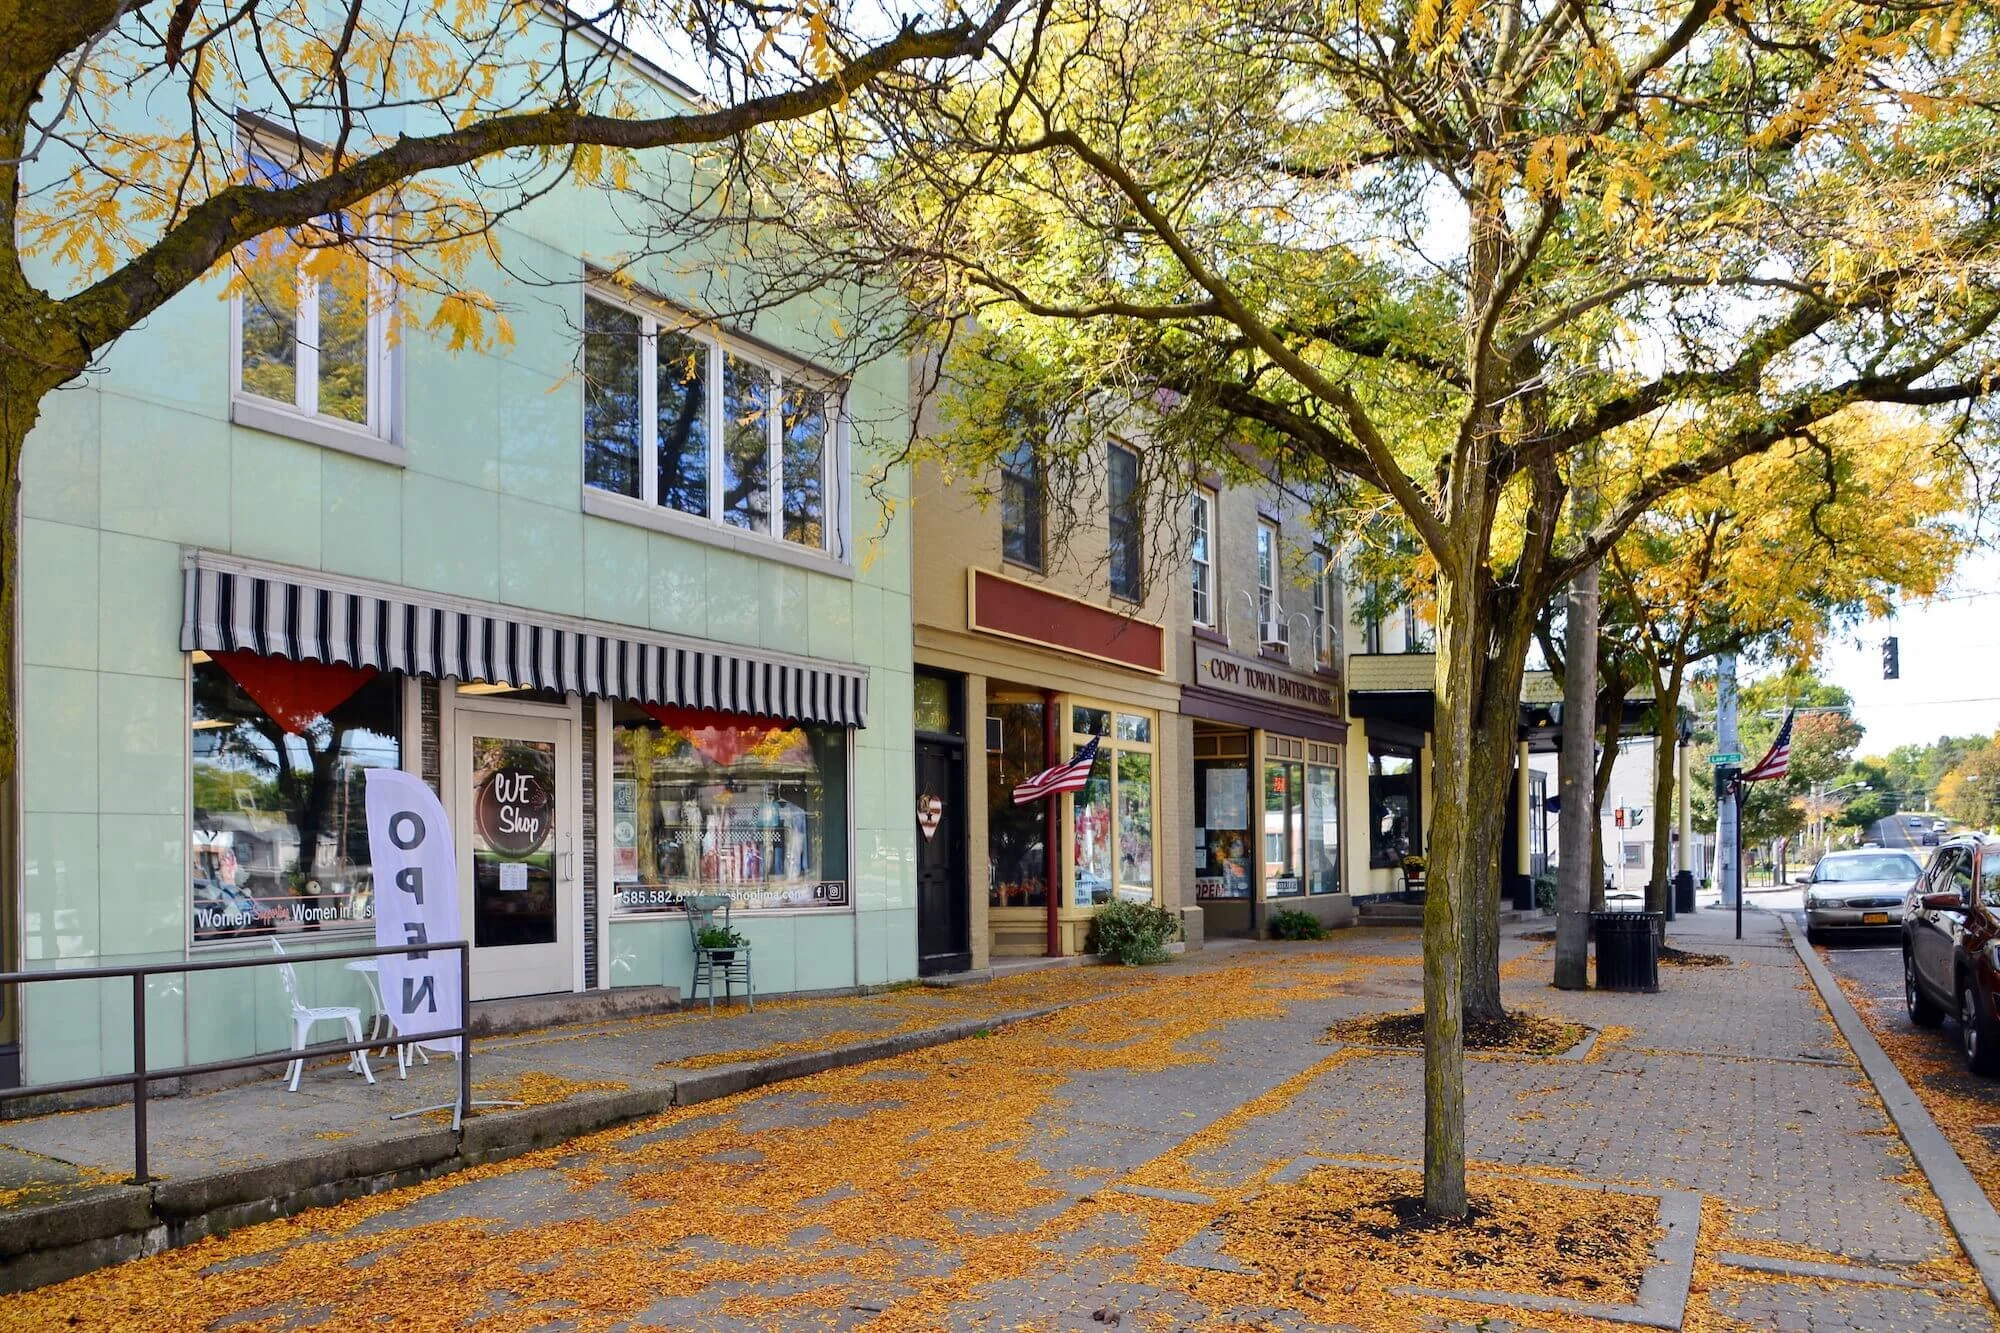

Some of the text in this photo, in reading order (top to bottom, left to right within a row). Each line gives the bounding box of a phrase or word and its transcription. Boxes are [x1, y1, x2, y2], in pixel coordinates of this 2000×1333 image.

[1211, 658, 1240, 684] COPY
[1244, 667, 1276, 693] TOWN
[495, 772, 534, 803] WE
[499, 805, 539, 842] Shop
[198, 909, 251, 928] Women
[292, 903, 337, 921] Women
[339, 902, 350, 919] in
